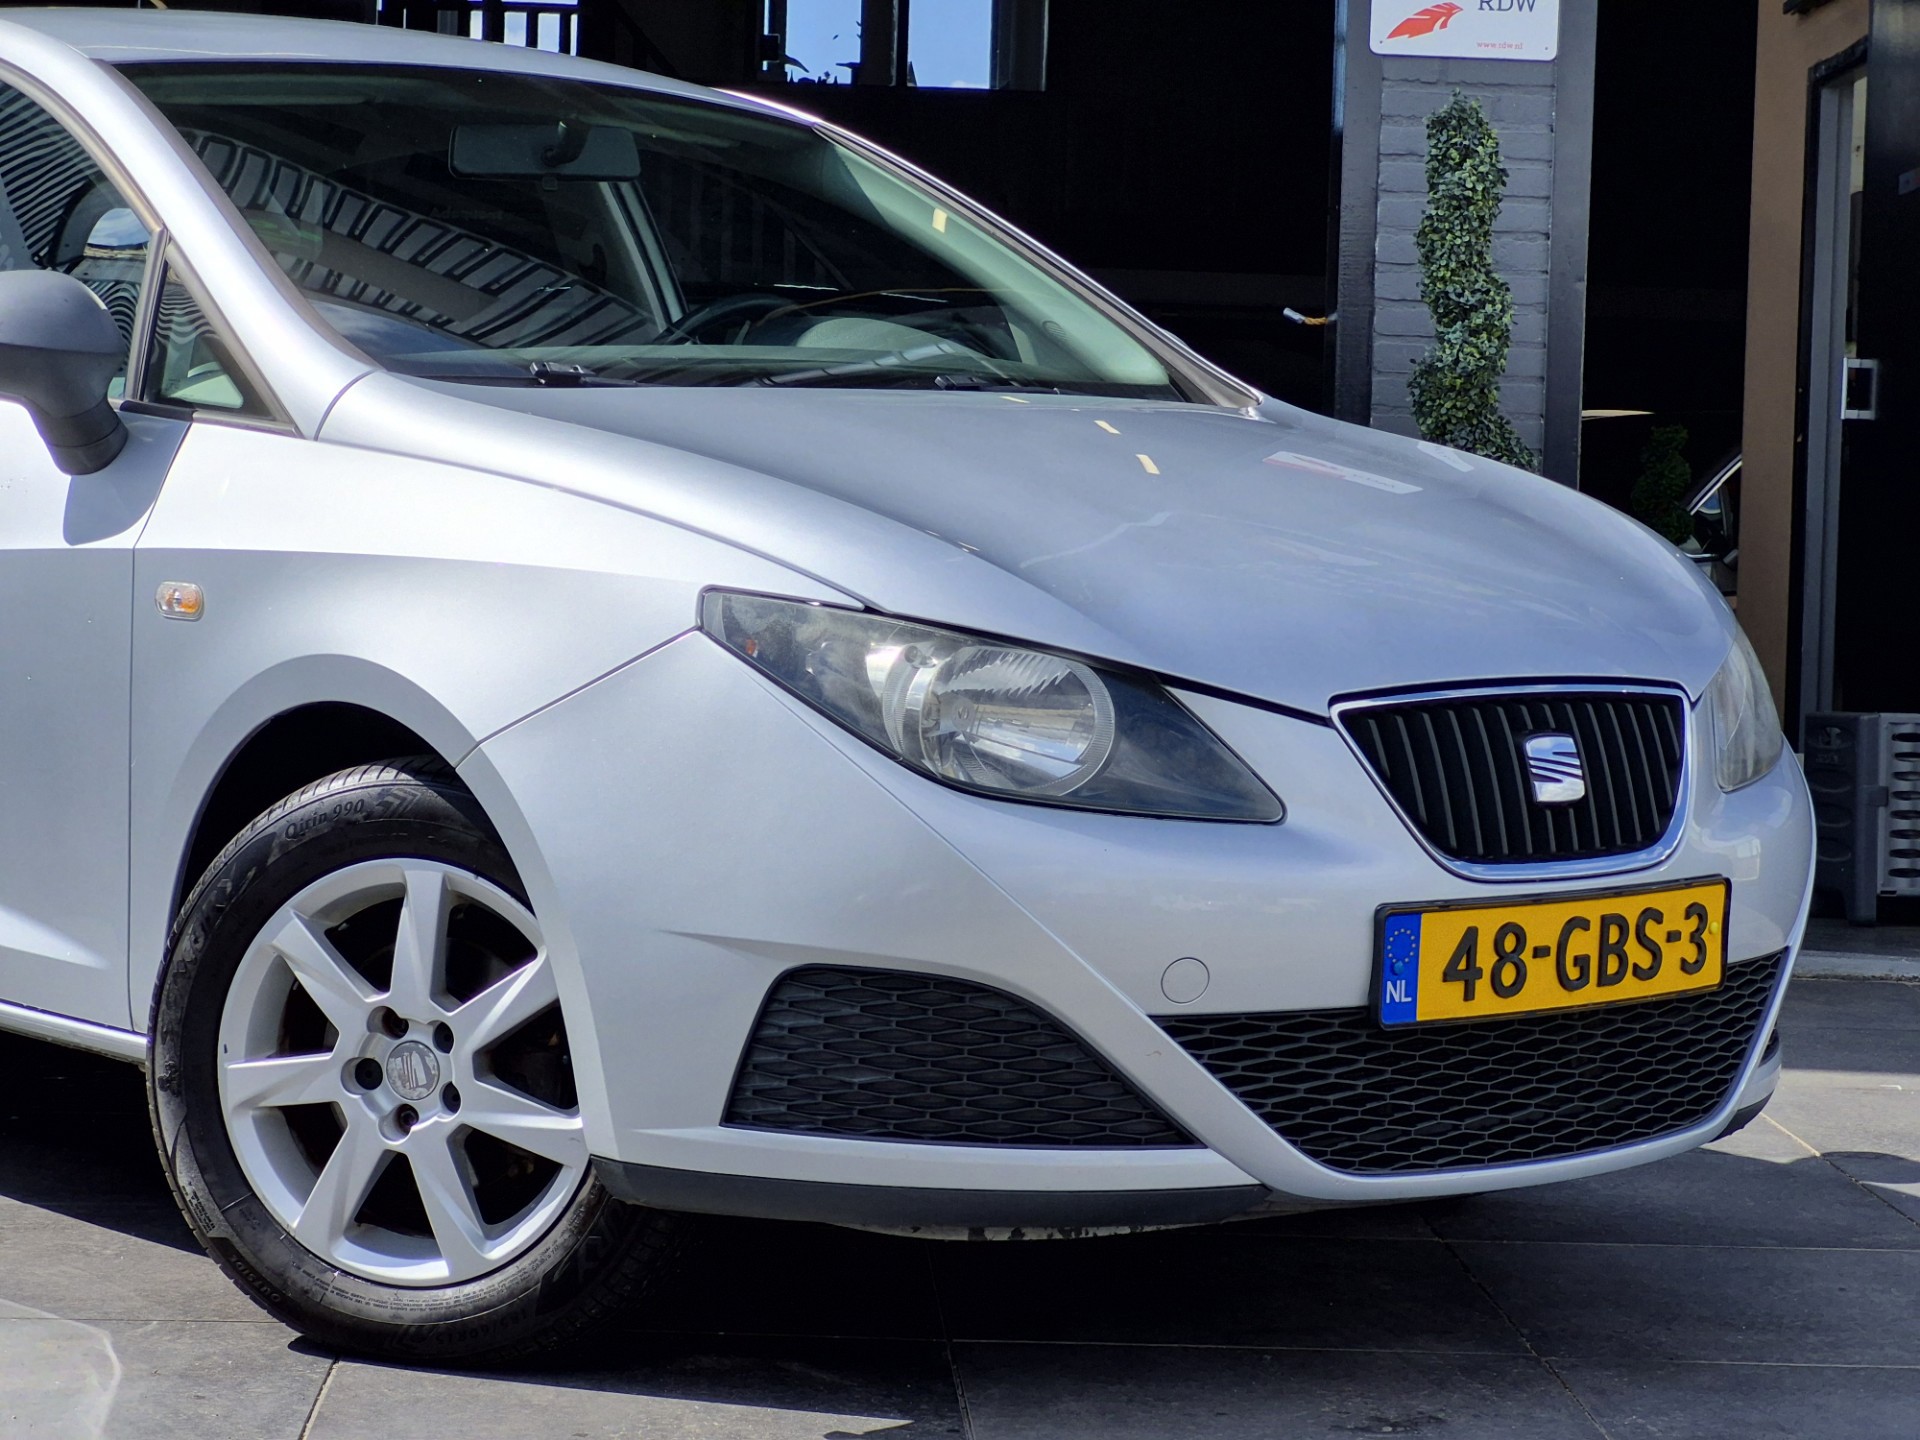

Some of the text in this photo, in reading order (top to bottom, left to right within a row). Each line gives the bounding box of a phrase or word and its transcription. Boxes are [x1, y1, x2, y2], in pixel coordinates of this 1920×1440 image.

[1478, 0, 1536, 12] RDW
[284, 799, 365, 840] Qirin 990
[1442, 901, 1709, 1002] 48-GBS-3
[1385, 979, 1412, 1004] NL
